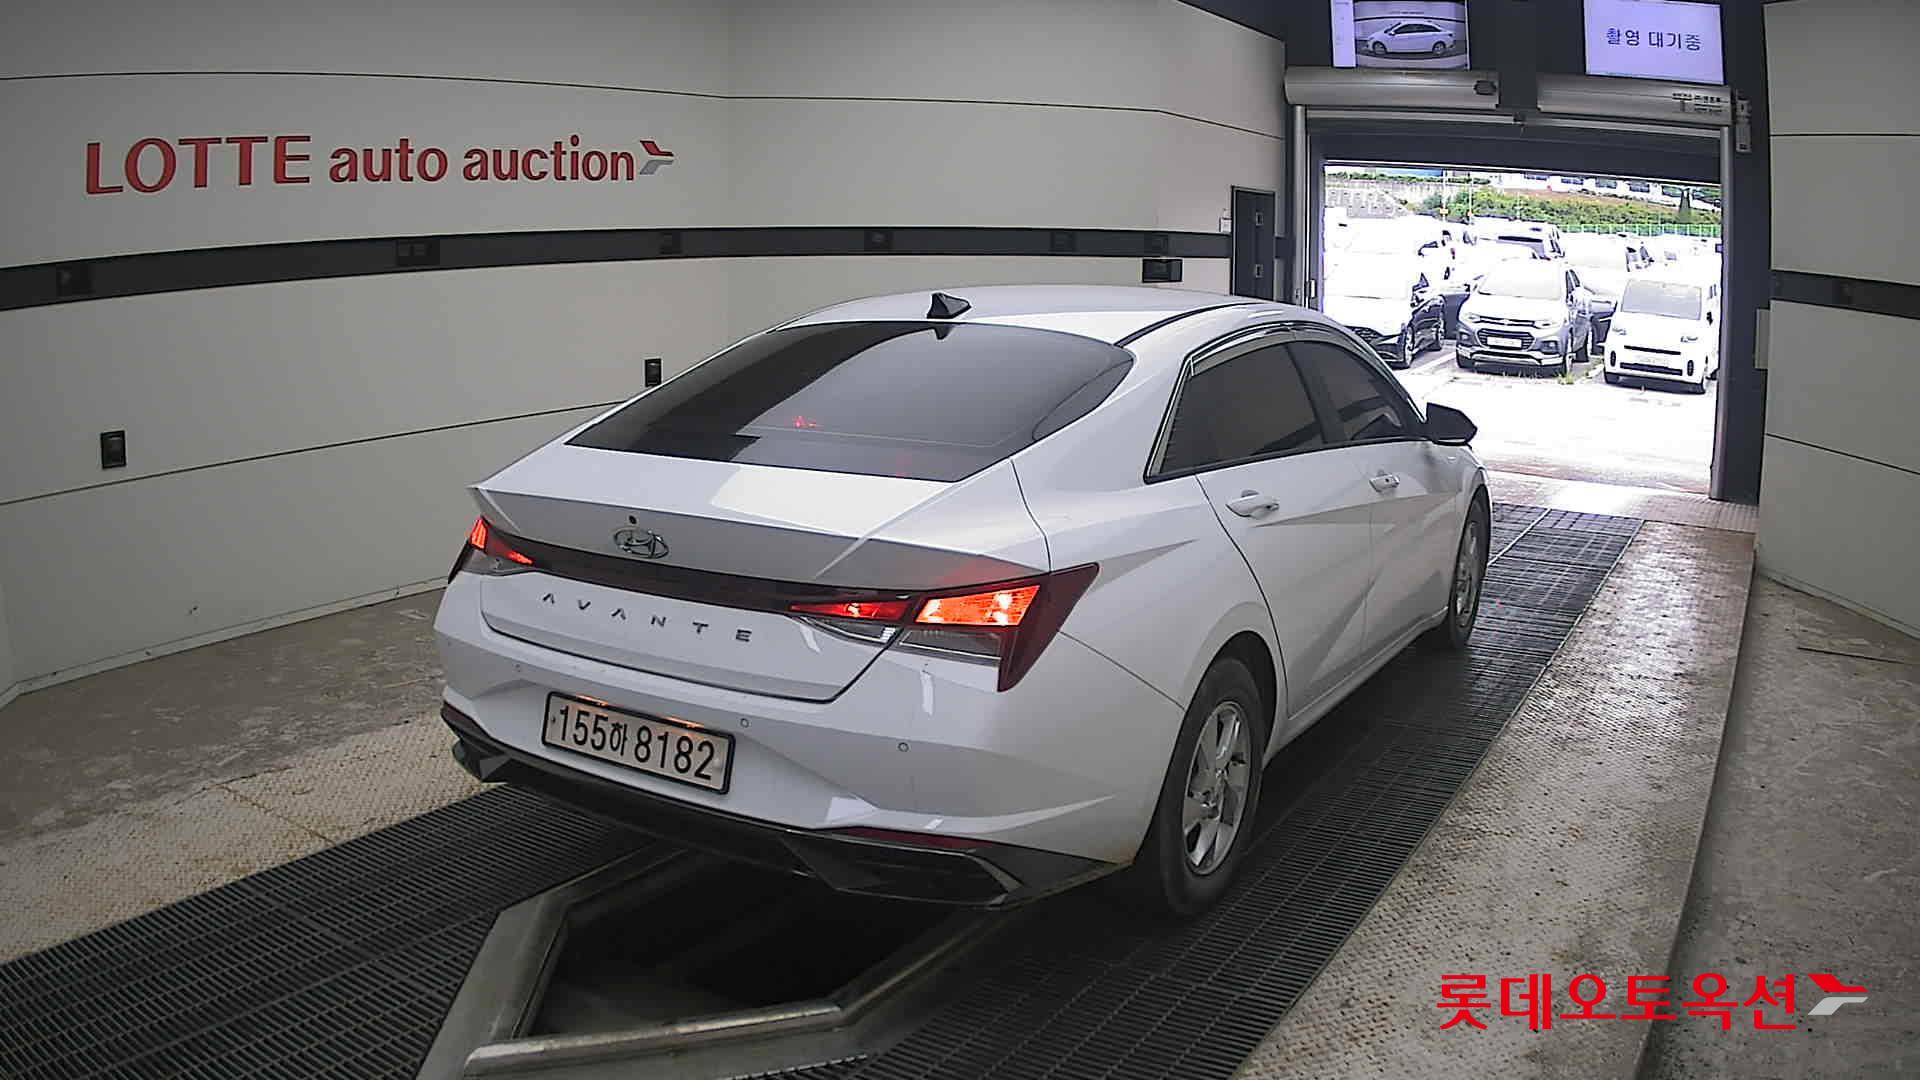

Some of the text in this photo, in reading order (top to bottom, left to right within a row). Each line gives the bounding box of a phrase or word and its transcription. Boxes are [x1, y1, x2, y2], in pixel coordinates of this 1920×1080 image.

[1648, 31, 1701, 51] 대기중
[86, 135, 634, 195] LOTTE auto auction
[542, 593, 752, 642] AVANTE
